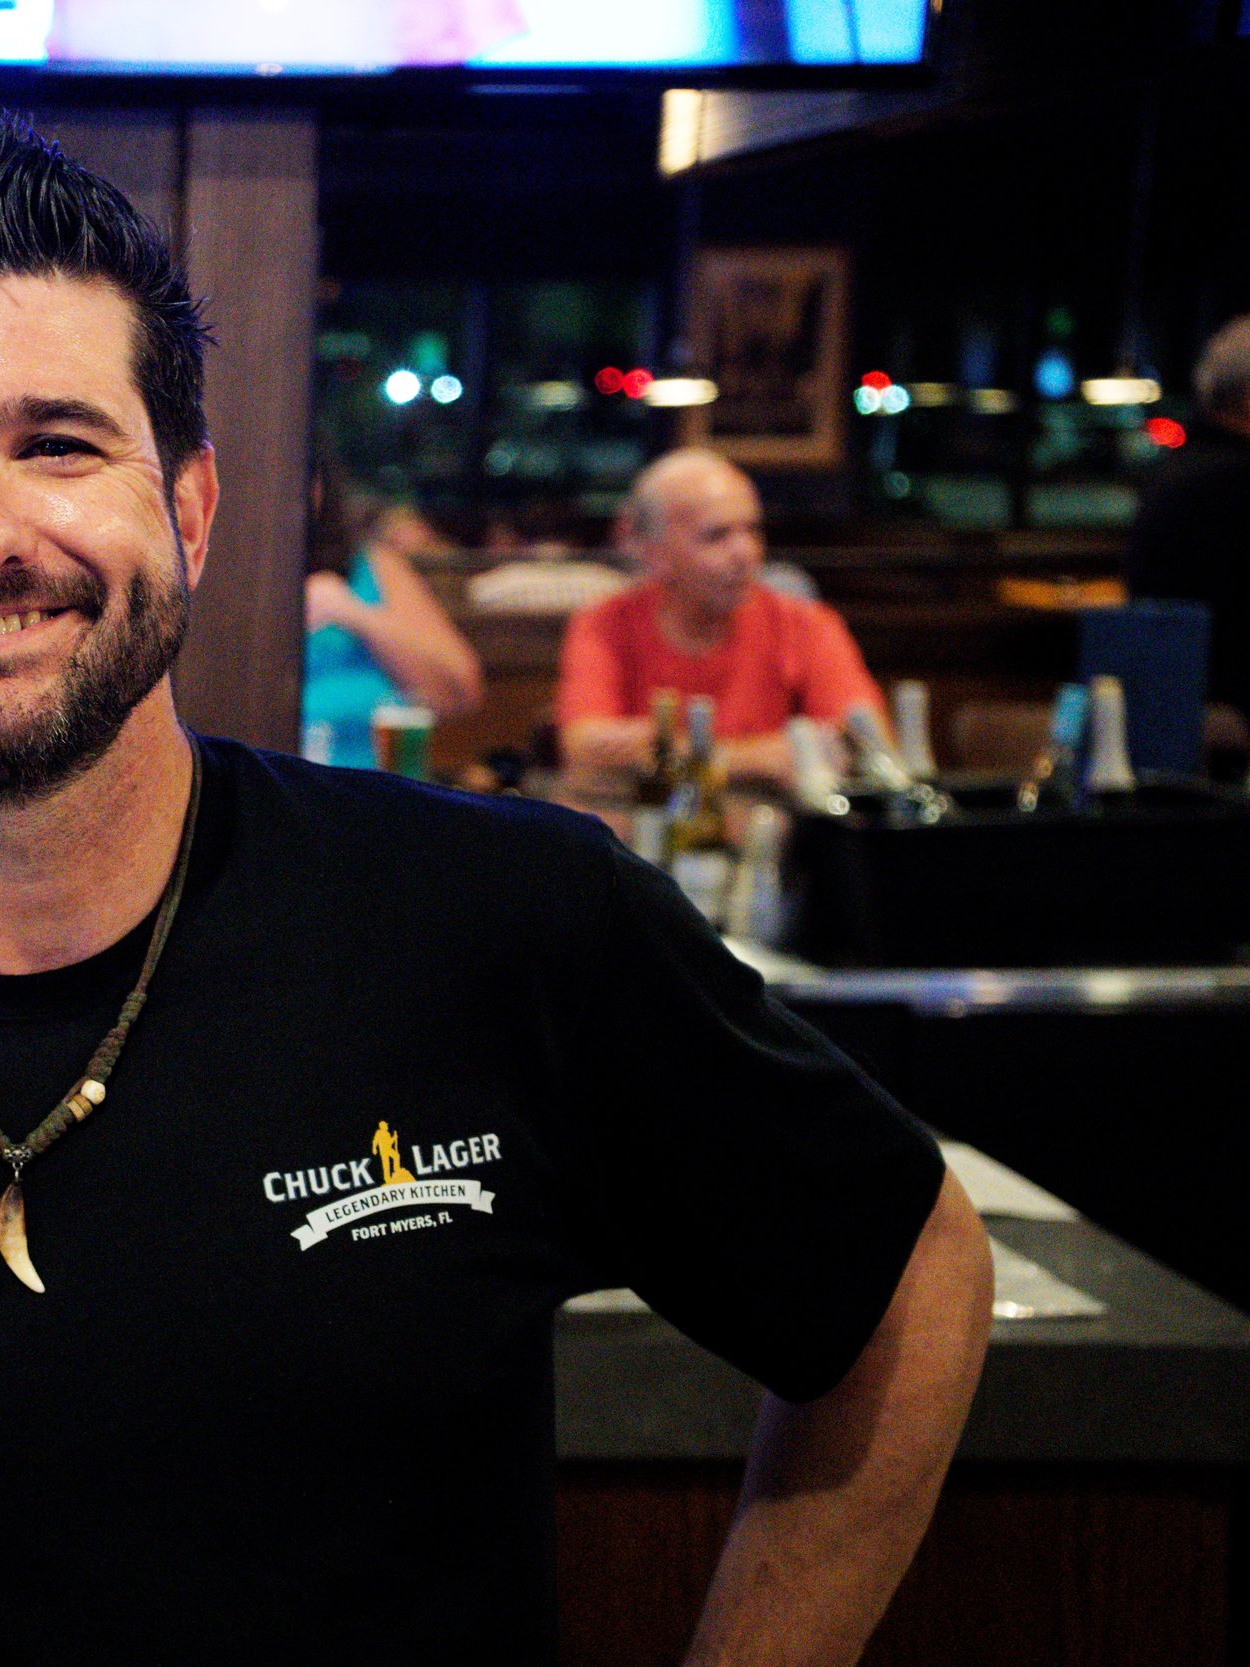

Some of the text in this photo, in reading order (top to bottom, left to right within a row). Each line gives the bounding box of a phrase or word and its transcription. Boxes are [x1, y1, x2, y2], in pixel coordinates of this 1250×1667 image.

[262, 1133, 502, 1203] CHUCK LAGER
[325, 1184, 466, 1223] LEGENDARY KITCHEN
[351, 1210, 454, 1242] FORT MYERS, FL
